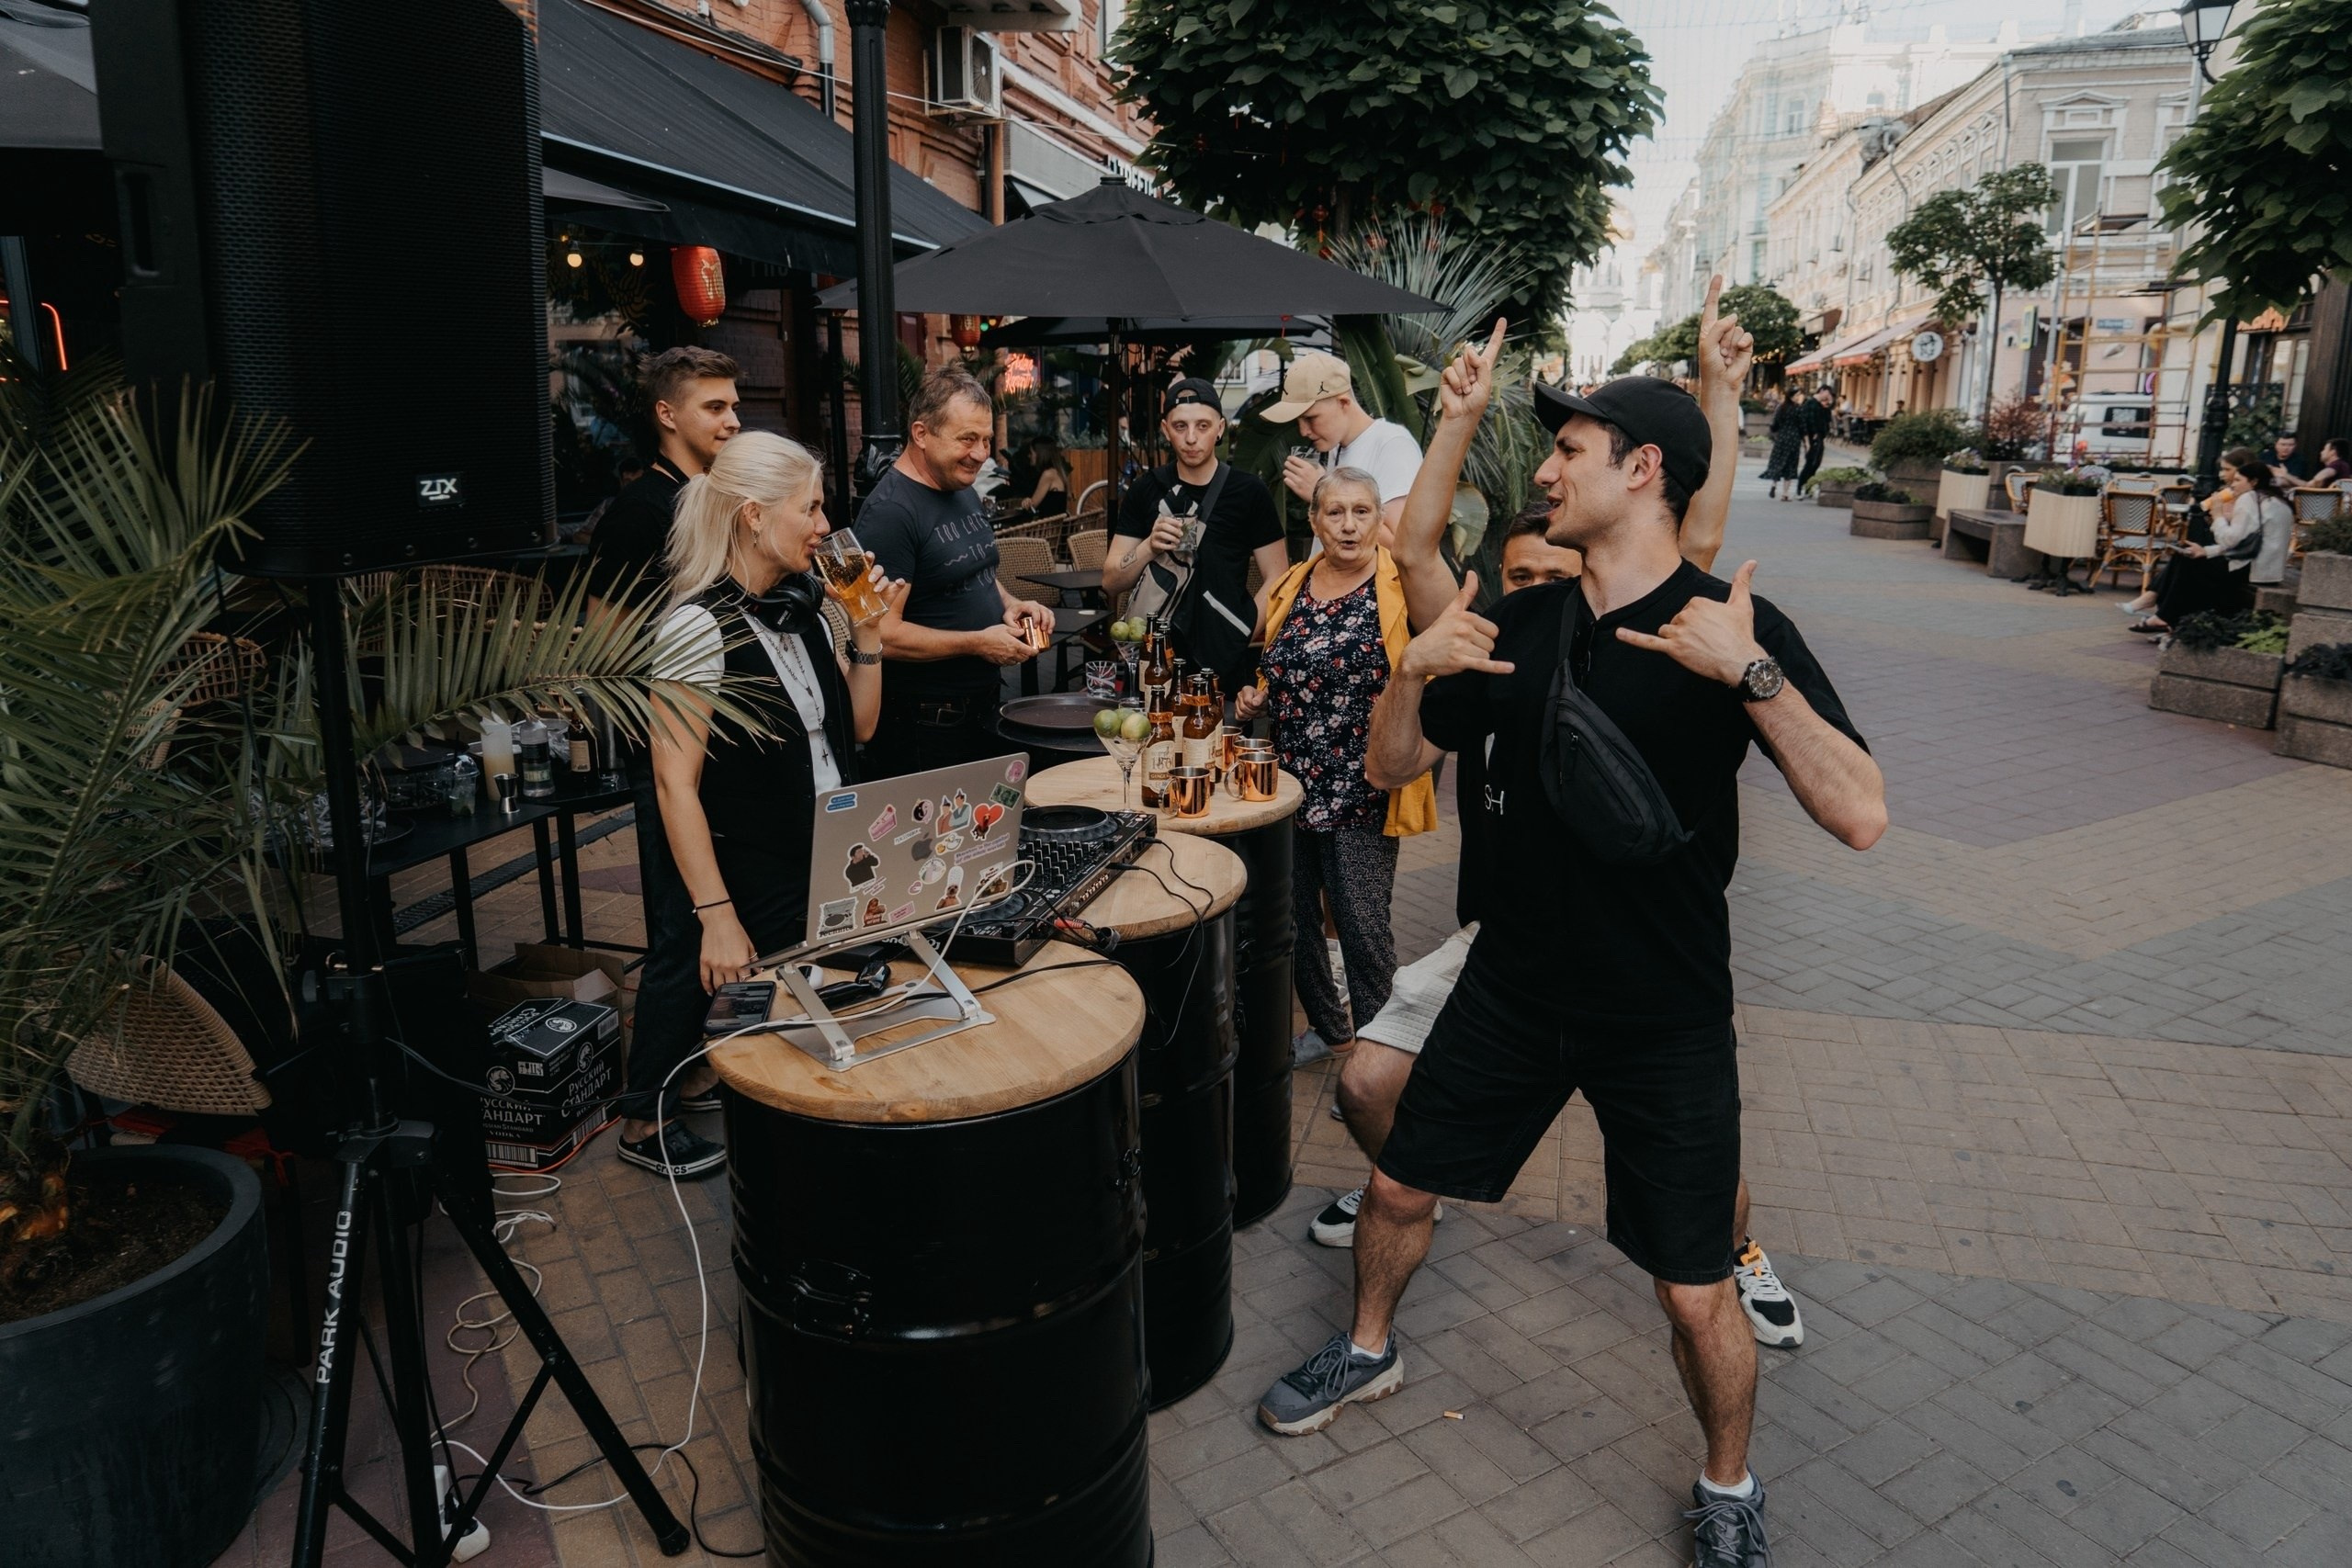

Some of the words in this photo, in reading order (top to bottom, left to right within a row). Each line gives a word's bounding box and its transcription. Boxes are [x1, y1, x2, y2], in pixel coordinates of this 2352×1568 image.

[934, 521, 960, 543] TOO
[968, 543, 986, 560] TO
[481, 1097, 531, 1111] УССКИЙ
[482, 1109, 544, 1125] АНДАРТ
[316, 1308, 340, 1383] PARK
[328, 1211, 352, 1299] AUDIO
